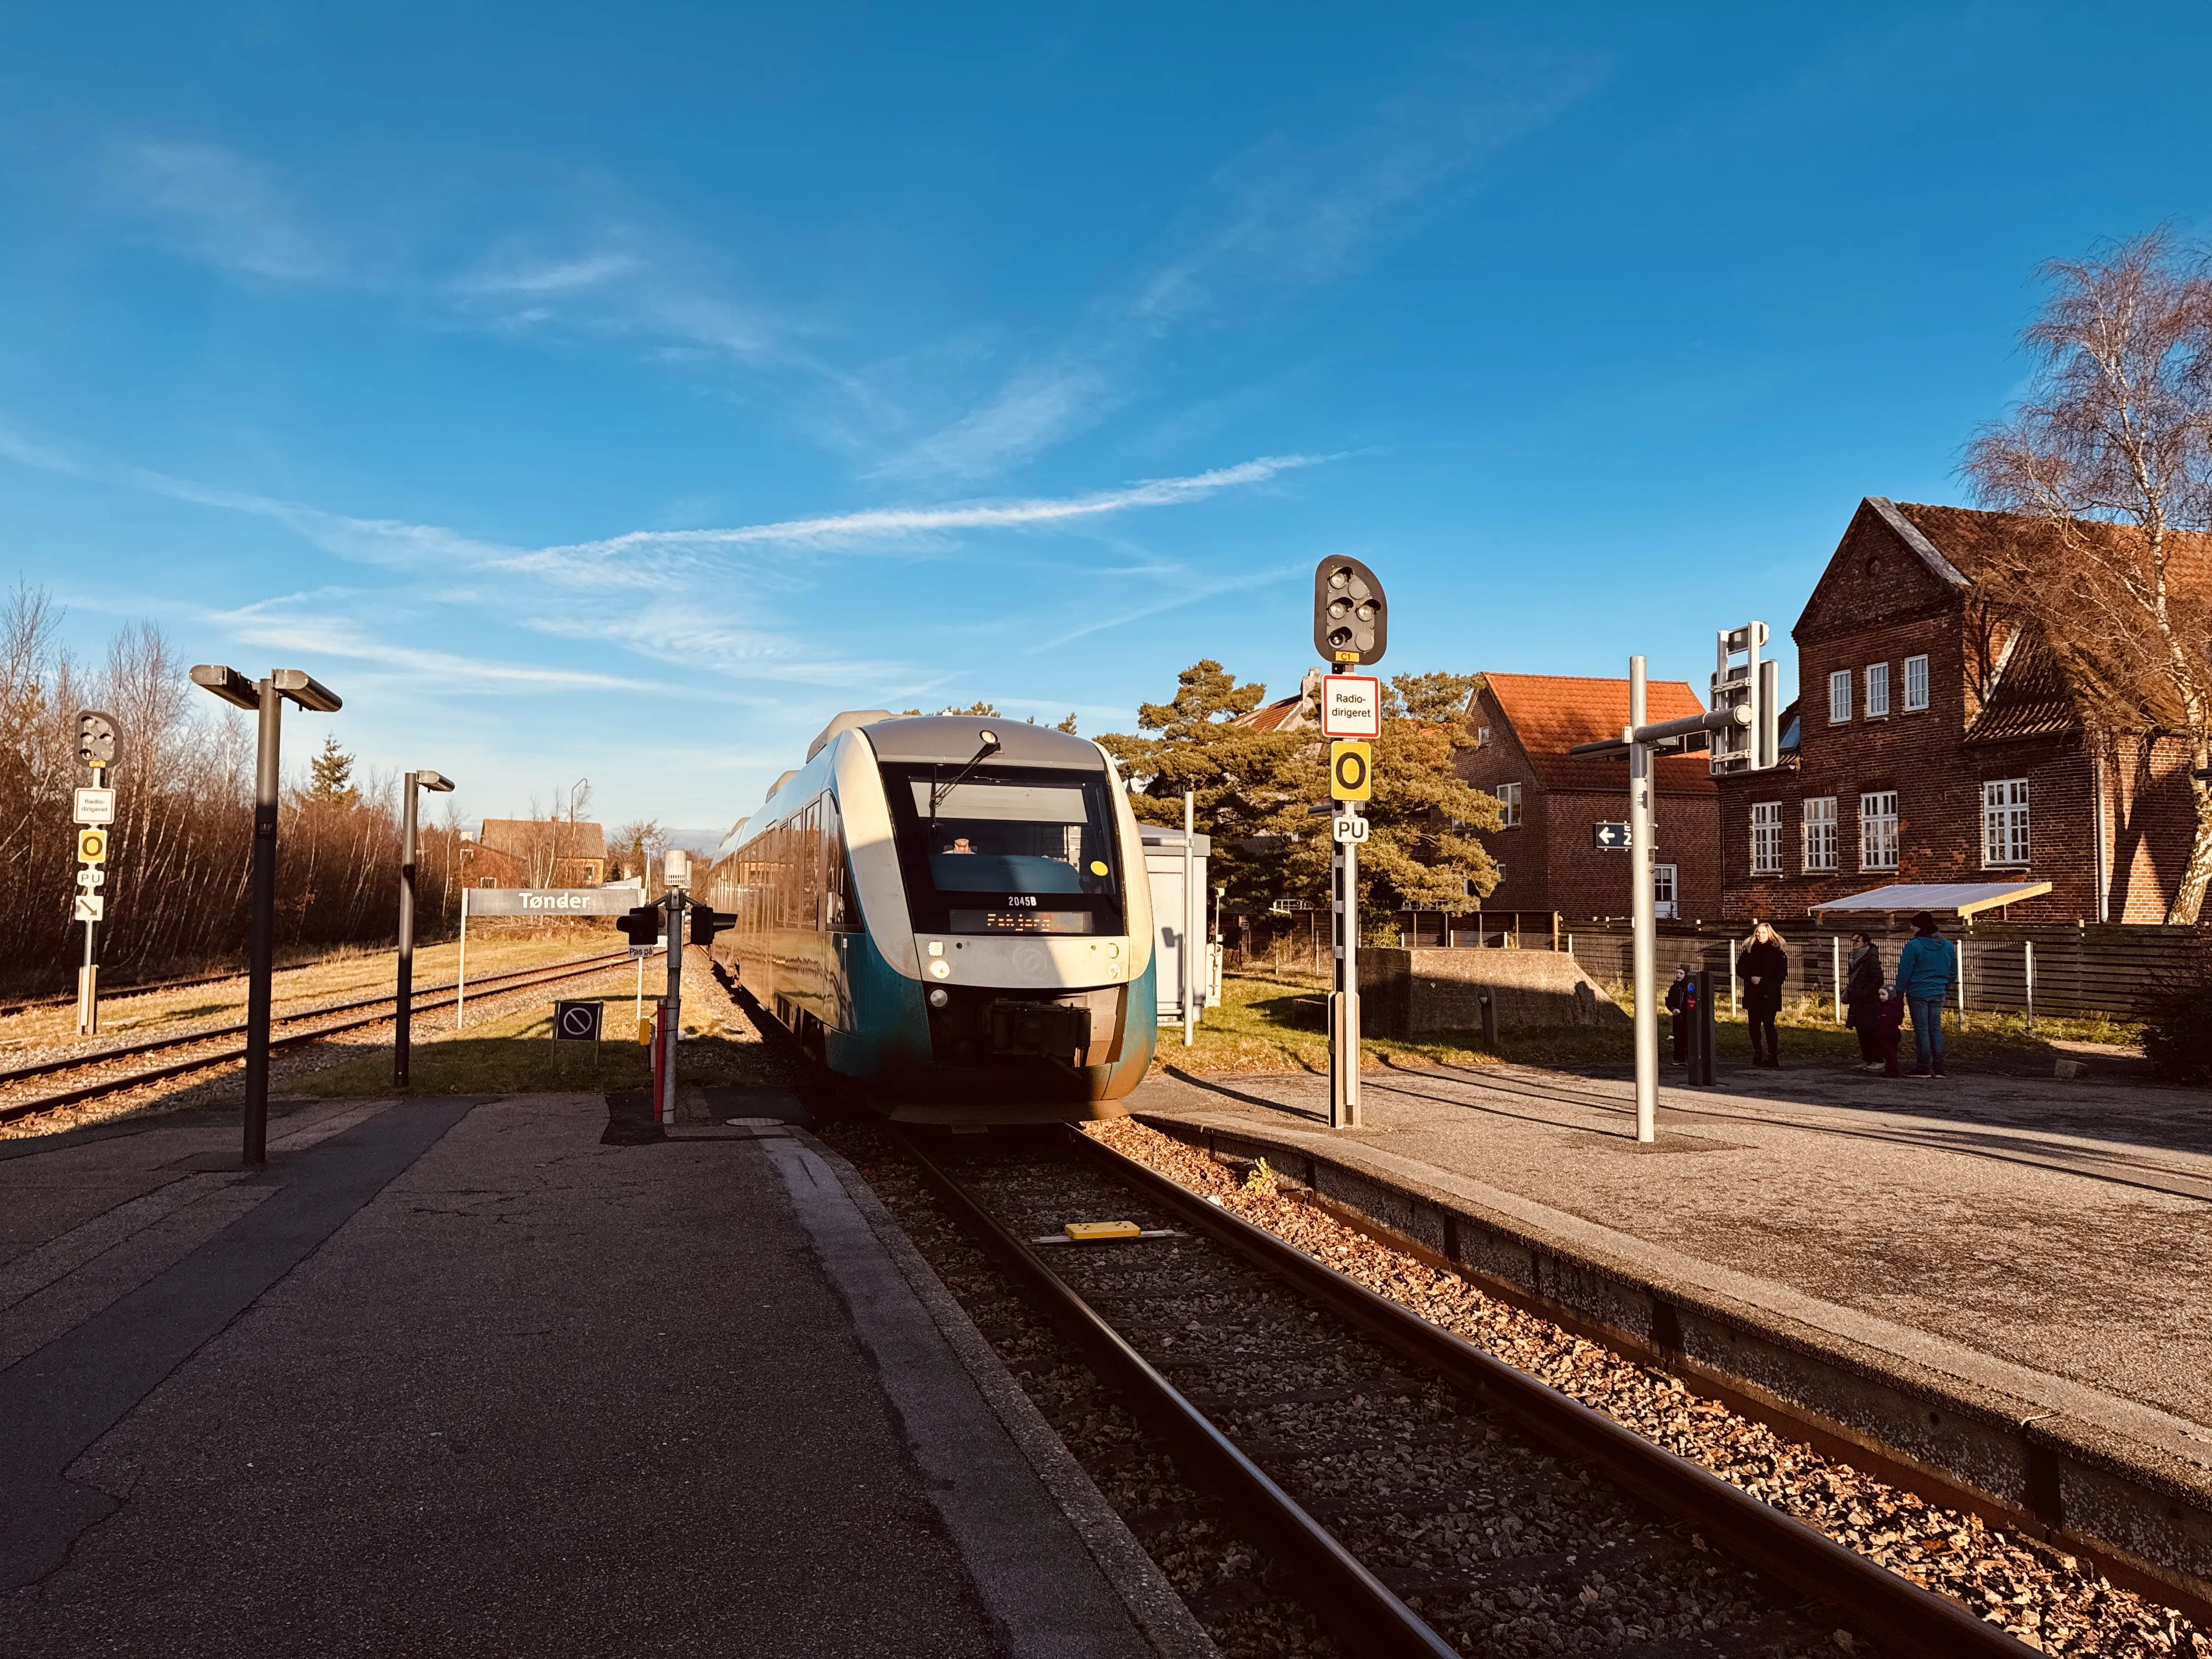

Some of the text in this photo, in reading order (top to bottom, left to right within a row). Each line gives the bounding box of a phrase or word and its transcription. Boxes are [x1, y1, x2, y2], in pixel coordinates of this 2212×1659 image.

[1336, 694, 1366, 703] Radio-
[1332, 708, 1370, 718] dirigeret
[1336, 752, 1366, 789] O
[1339, 821, 1364, 838] PU
[82, 836, 103, 856] O
[81, 874, 100, 883] PU
[518, 892, 590, 909] Tønder
[1008, 896, 1036, 906] 2045B
[629, 946, 652, 956] Pas på
